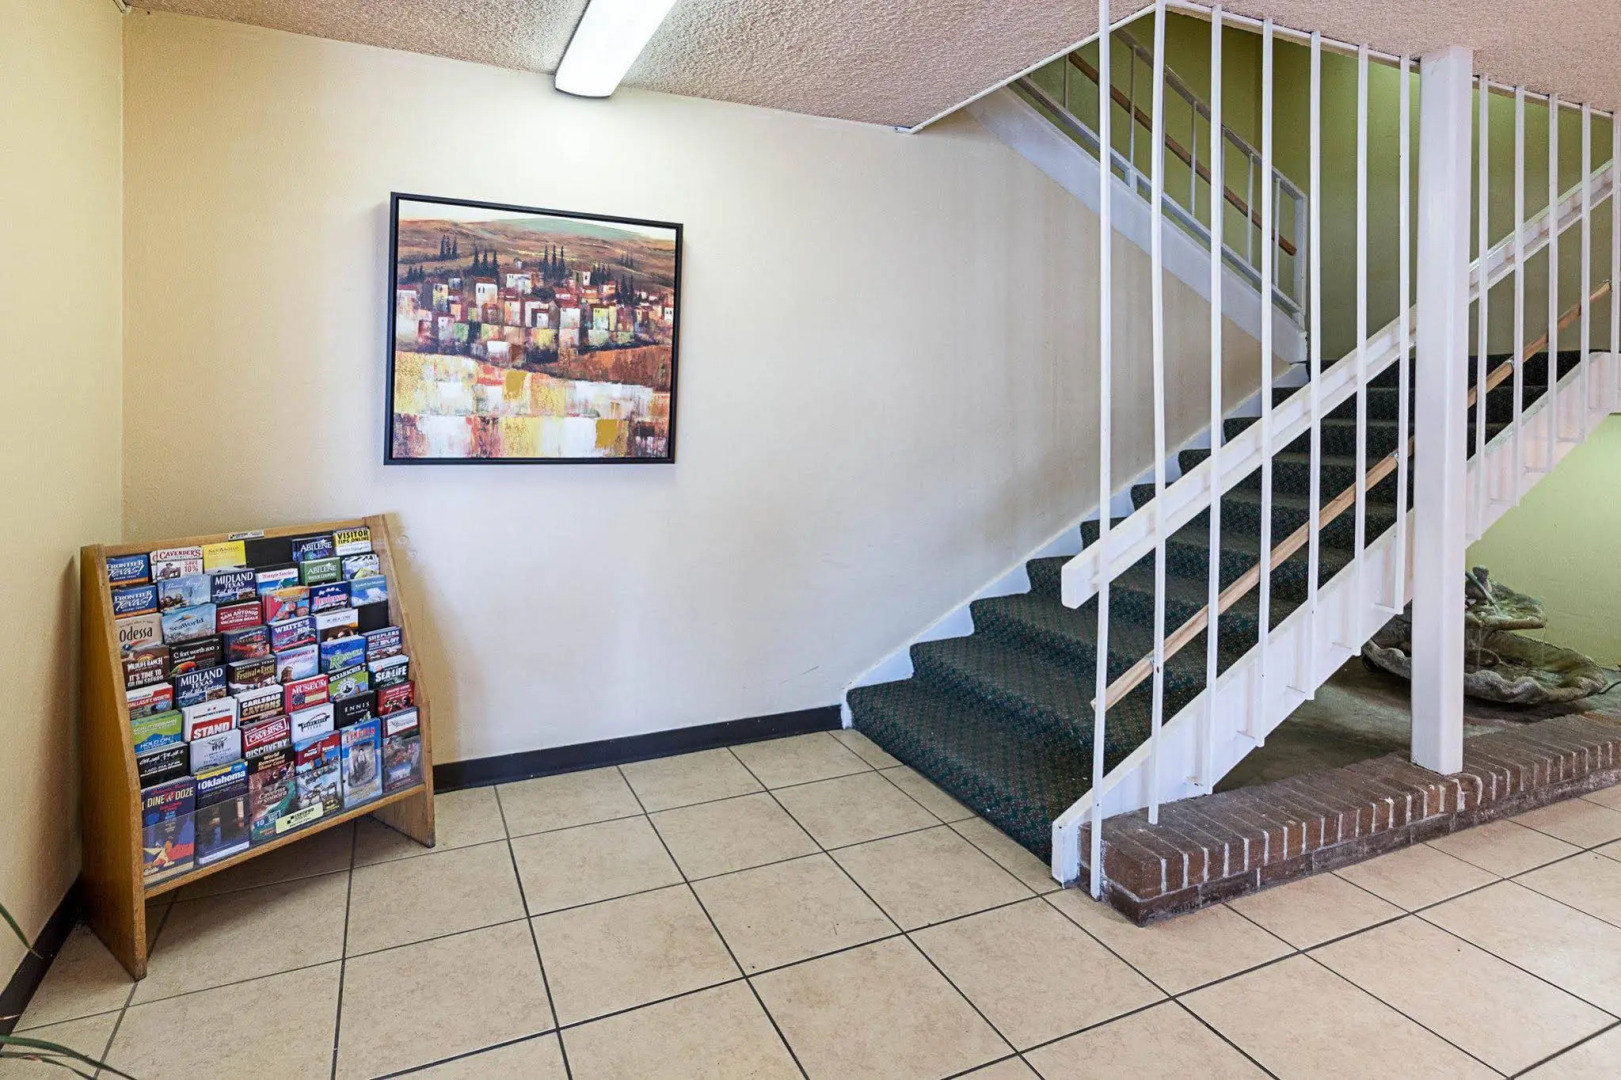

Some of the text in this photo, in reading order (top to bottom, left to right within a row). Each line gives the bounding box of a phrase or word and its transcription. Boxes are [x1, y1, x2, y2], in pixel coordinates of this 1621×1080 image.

[337, 529, 369, 541] VISITOR
[159, 549, 201, 560] CAVENDER'S
[215, 571, 254, 586] MIDLAND
[224, 581, 245, 589] TEXAS
[169, 617, 204, 632] SeaWorld
[274, 619, 310, 634] WHITE'S
[119, 626, 153, 642] Odessa
[129, 672, 140, 682] IT'S
[141, 670, 154, 679] TIME
[180, 667, 223, 687] MIDLAND
[191, 679, 214, 689] TEXAS
[291, 680, 327, 695] MUSEUM
[242, 693, 281, 708] CARLSBAD
[344, 701, 370, 713] ENNIS
[242, 700, 281, 717] CAVERNS
[193, 721, 231, 740] STAND
[201, 770, 246, 790] Oklahoma
[147, 794, 165, 808] DINE
[175, 786, 194, 801] DOZE
